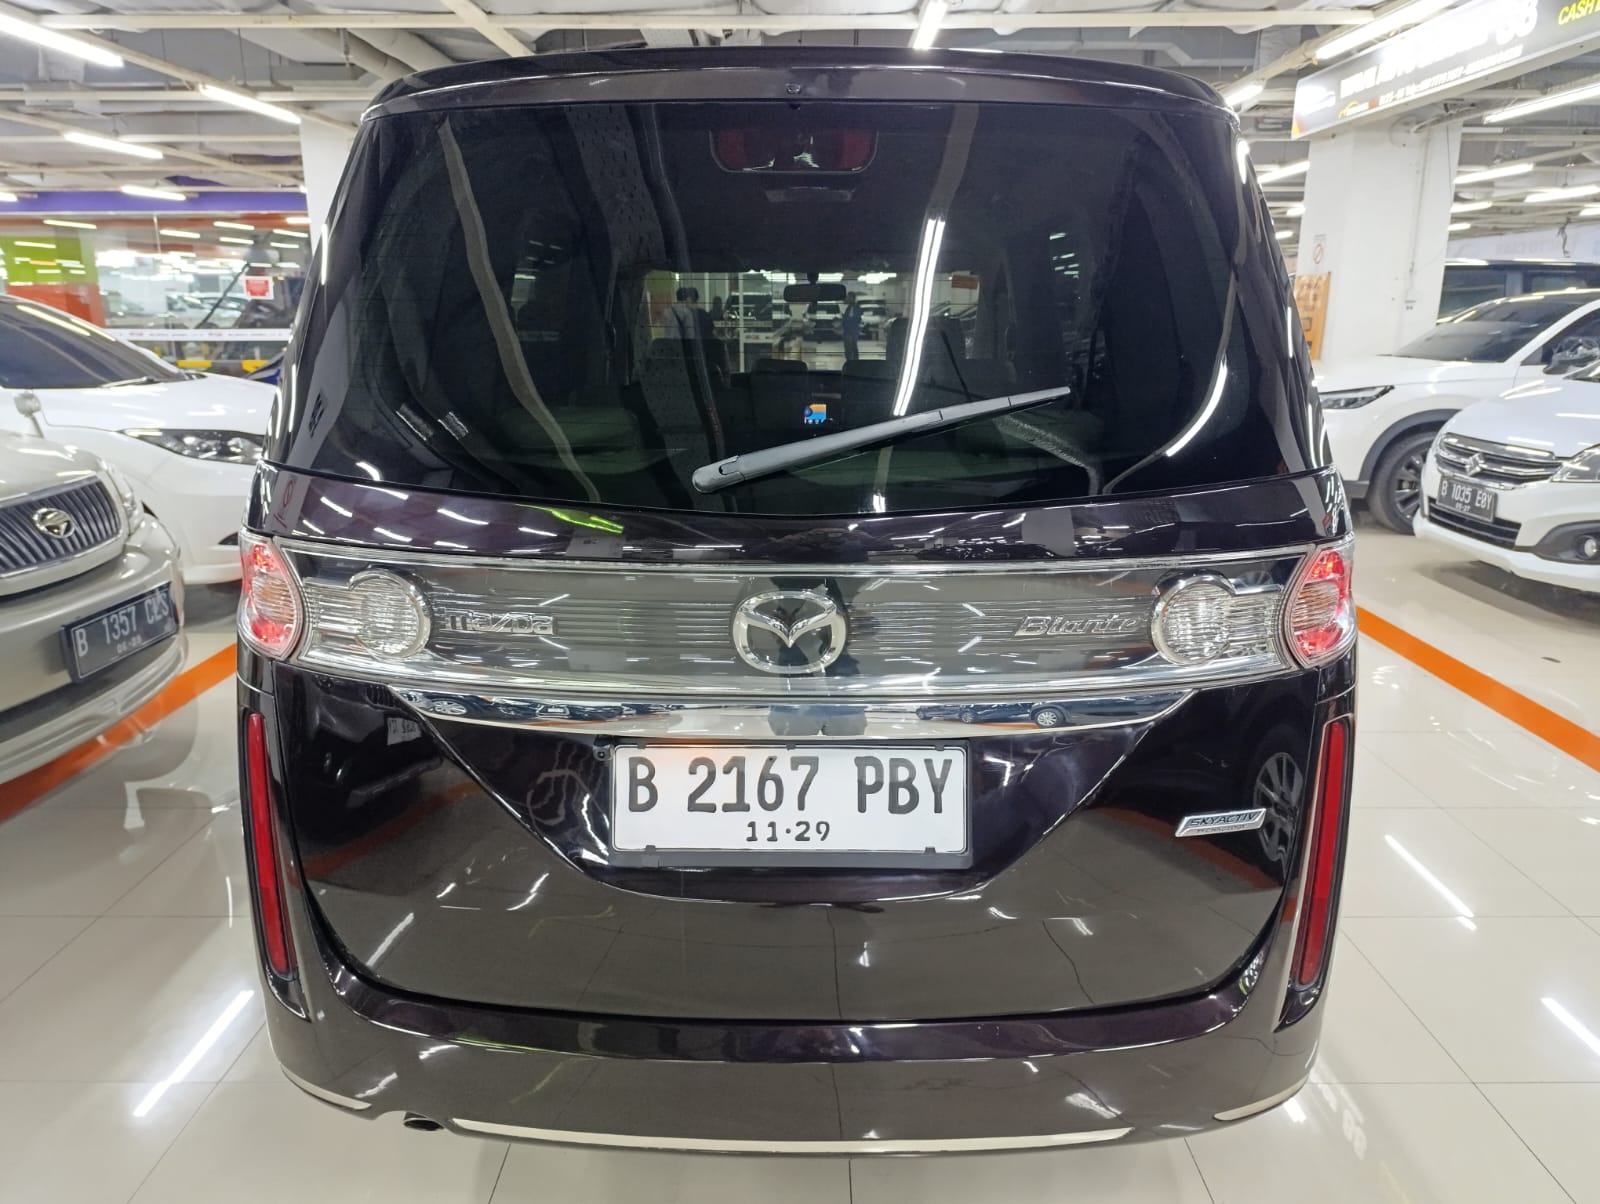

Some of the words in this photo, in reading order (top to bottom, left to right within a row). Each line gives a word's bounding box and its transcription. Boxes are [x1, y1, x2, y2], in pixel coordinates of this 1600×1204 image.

[1451, 484, 1472, 503] 1035
[75, 628, 89, 657] B
[102, 605, 137, 645] 1357
[1015, 614, 1138, 636] Biante
[628, 756, 658, 812] B
[687, 756, 820, 813] 2167
[854, 756, 953, 814] PBY
[1191, 812, 1256, 826] SKYACTIV
